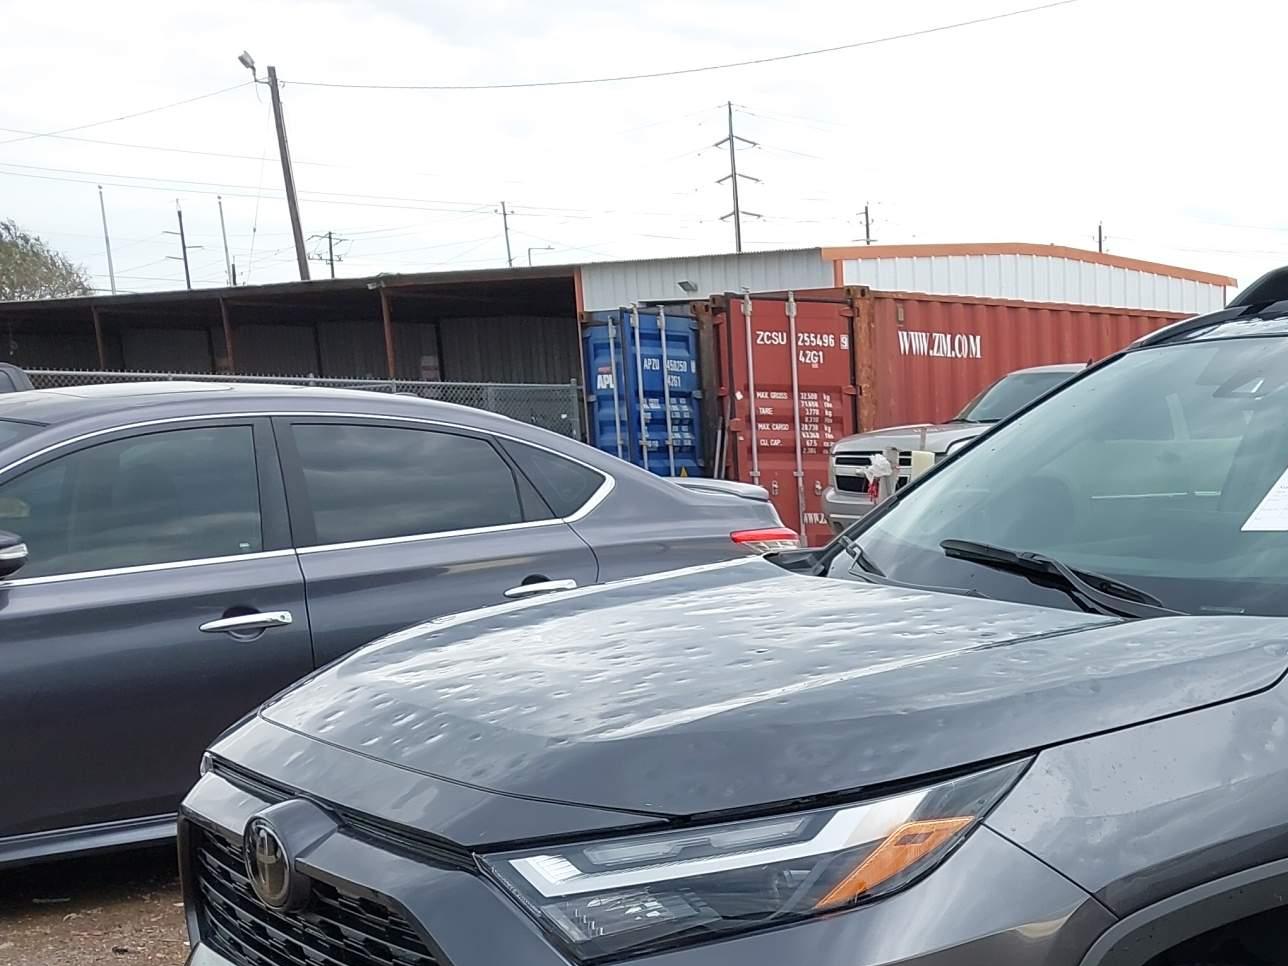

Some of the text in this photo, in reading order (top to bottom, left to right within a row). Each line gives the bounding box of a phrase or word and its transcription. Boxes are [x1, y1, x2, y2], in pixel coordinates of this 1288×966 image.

[756, 331, 787, 345] ZCSU
[797, 333, 835, 347] 255496
[898, 331, 981, 358] WWW.ZIM.COM
[799, 350, 823, 363] 42G1
[597, 374, 615, 389] APL
